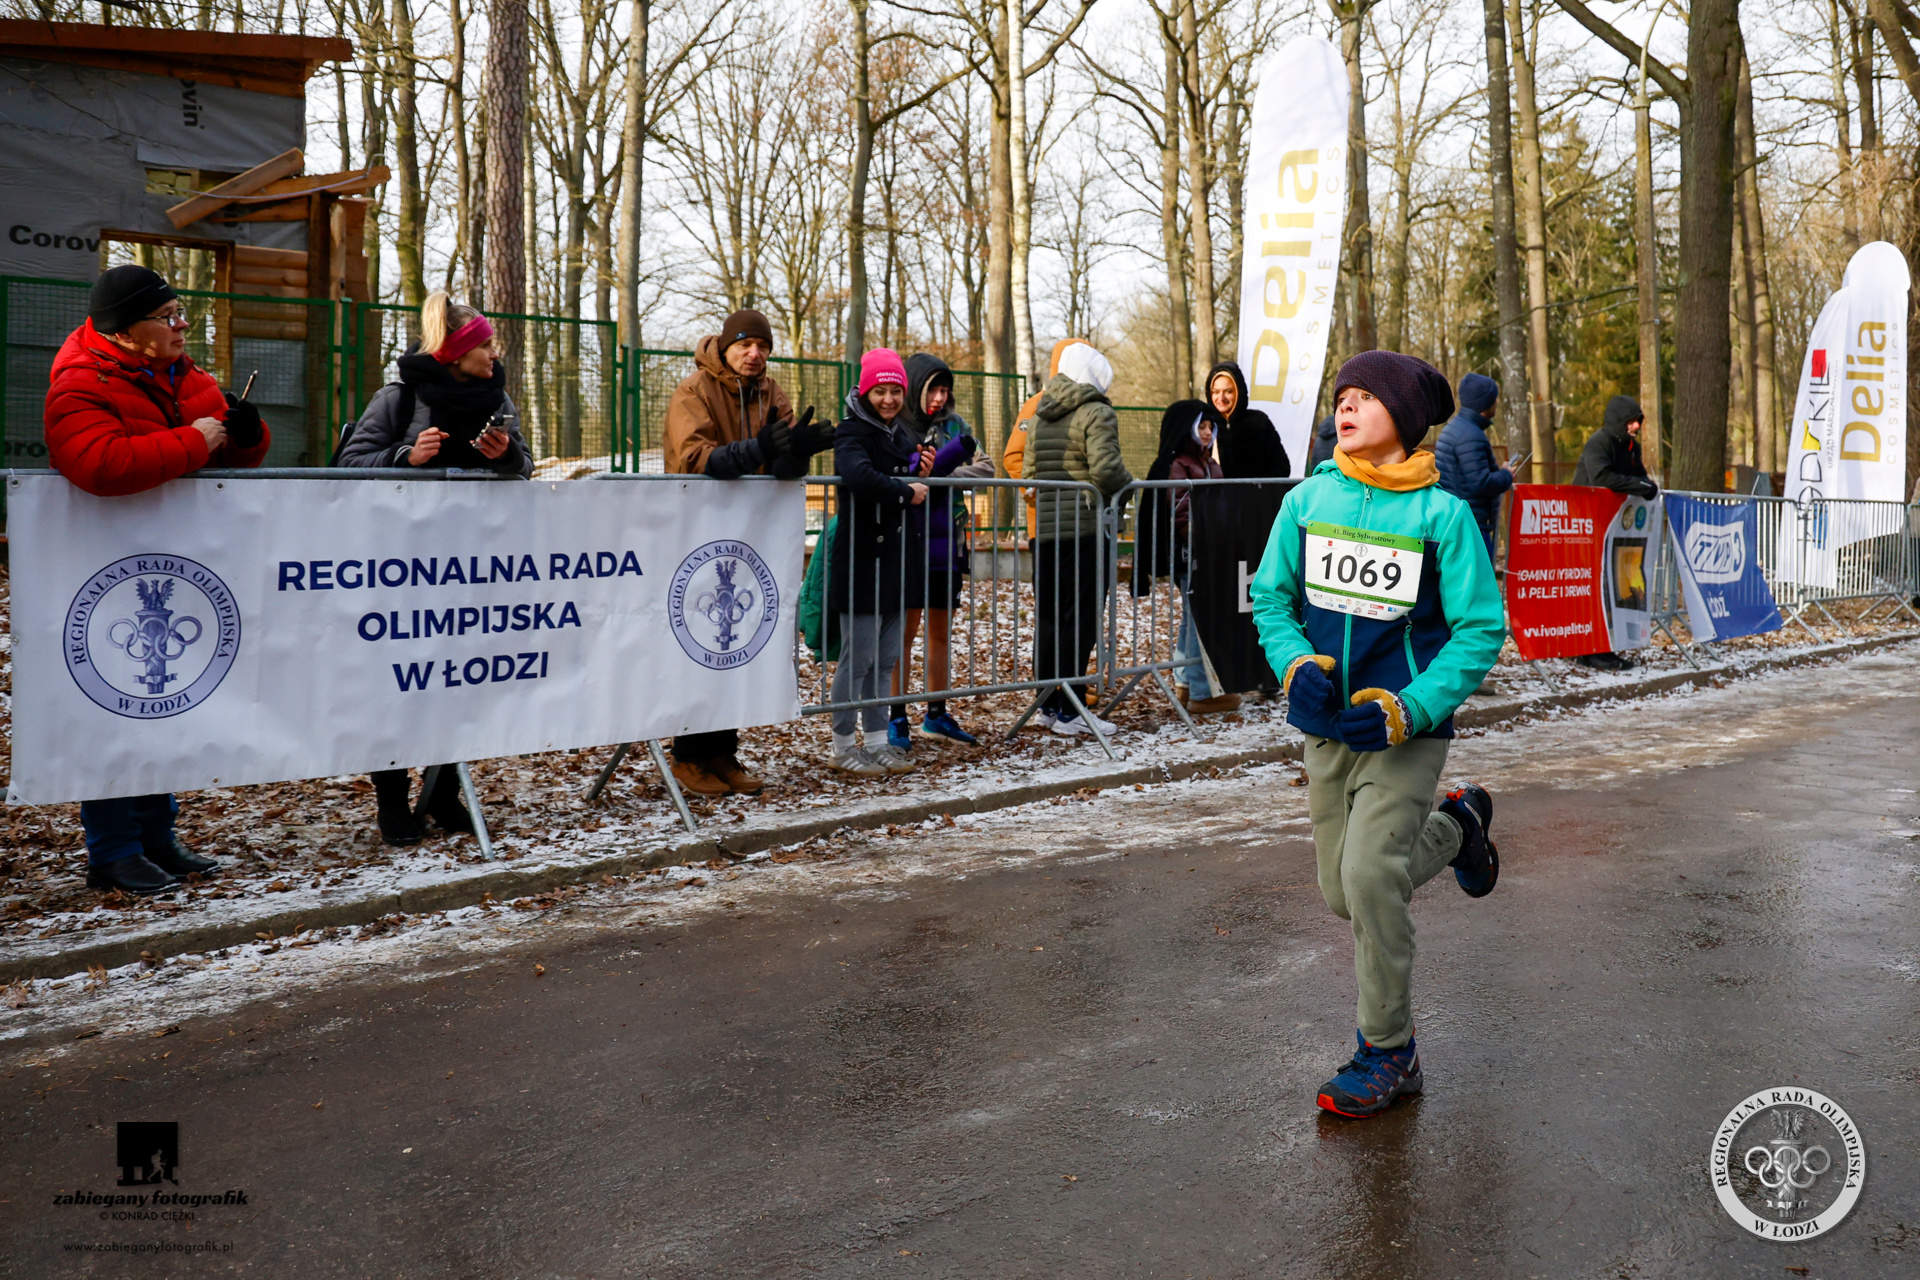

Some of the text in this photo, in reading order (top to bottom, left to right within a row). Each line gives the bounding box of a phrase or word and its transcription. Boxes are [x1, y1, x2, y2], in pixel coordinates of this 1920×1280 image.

[1250, 148, 1319, 403] Delia
[1291, 145, 1341, 406] COSMETICS
[1839, 321, 1887, 463] Delia
[1541, 518, 1593, 534] PELLETS
[278, 550, 644, 591] REGIONALNA RADA
[672, 544, 776, 628] REGIONALNA RADA OLIMPIJSKA
[1321, 552, 1402, 591] 1069
[71, 559, 236, 665] REGIONALNA RADA OLIMPIJSKA
[357, 601, 582, 641] OLIMPIJSKA
[392, 651, 549, 692] W ŁODZI
[704, 653, 713, 663] W
[117, 692, 191, 714] W ŁODZI
